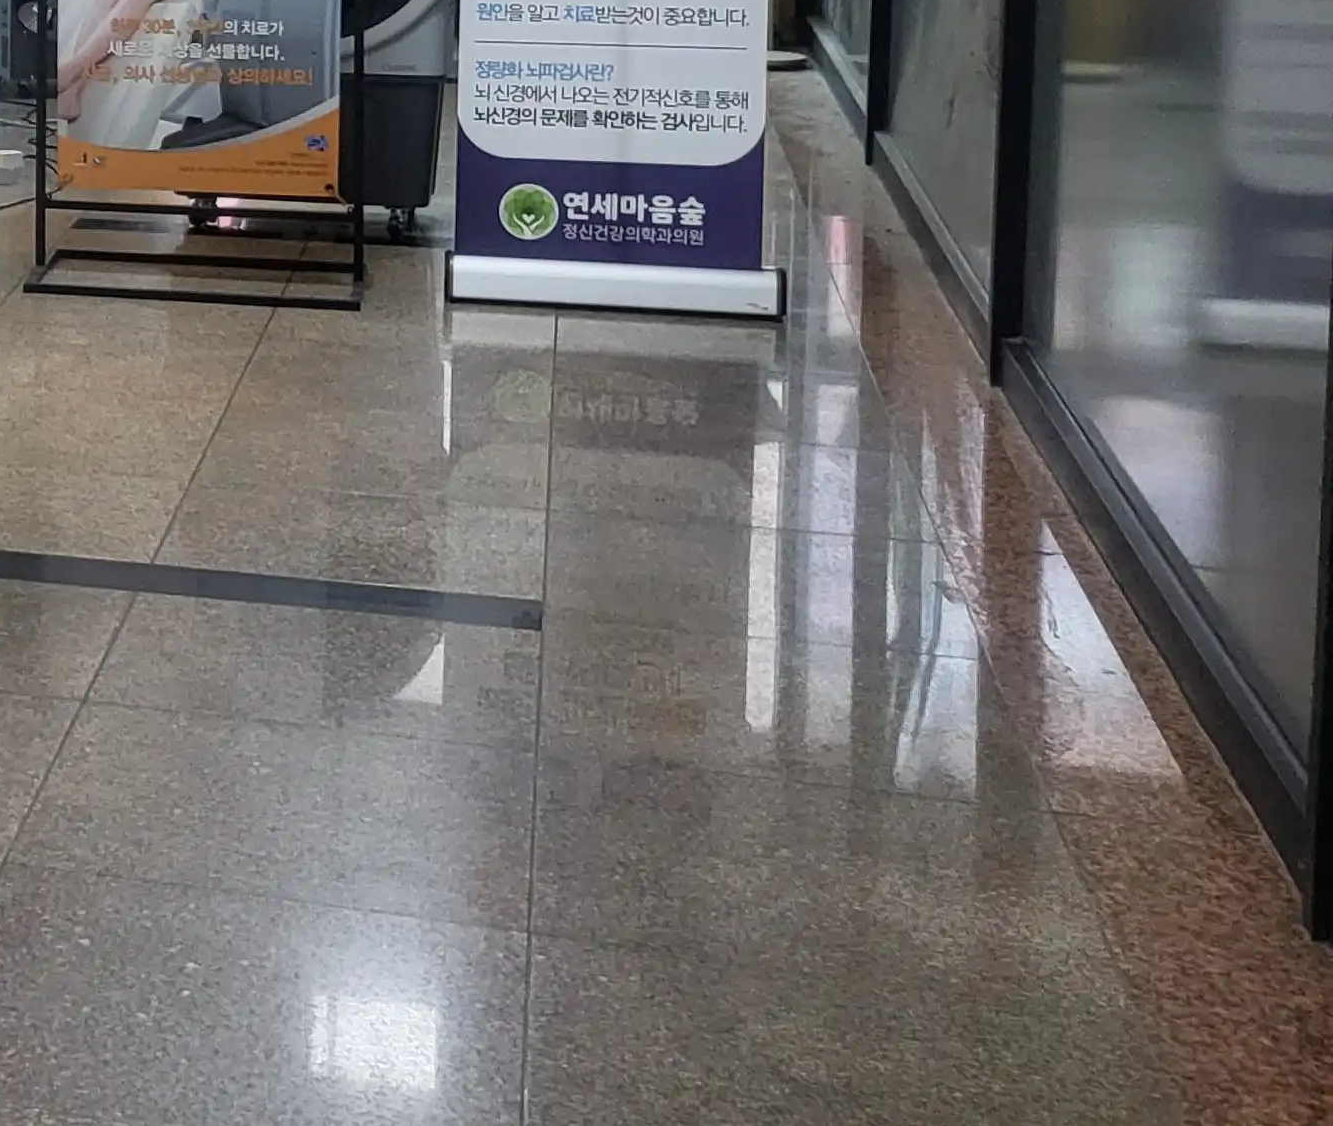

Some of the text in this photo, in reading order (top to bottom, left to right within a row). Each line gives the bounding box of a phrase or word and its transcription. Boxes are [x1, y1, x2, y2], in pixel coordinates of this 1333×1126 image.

[476, 2, 750, 27] 원인을 알고 치료받는것이 중요합니다.
[475, 61, 614, 82] 정량화 뇌파검사란?
[474, 84, 750, 111] 뇌 신경에서 나오는 전기적신호를 통해
[473, 107, 748, 134] 뇌신경의 문제를 확인하는 검사입니다.
[563, 191, 706, 226] 연세마음숲
[562, 224, 705, 246] 정신건강의학과의원
